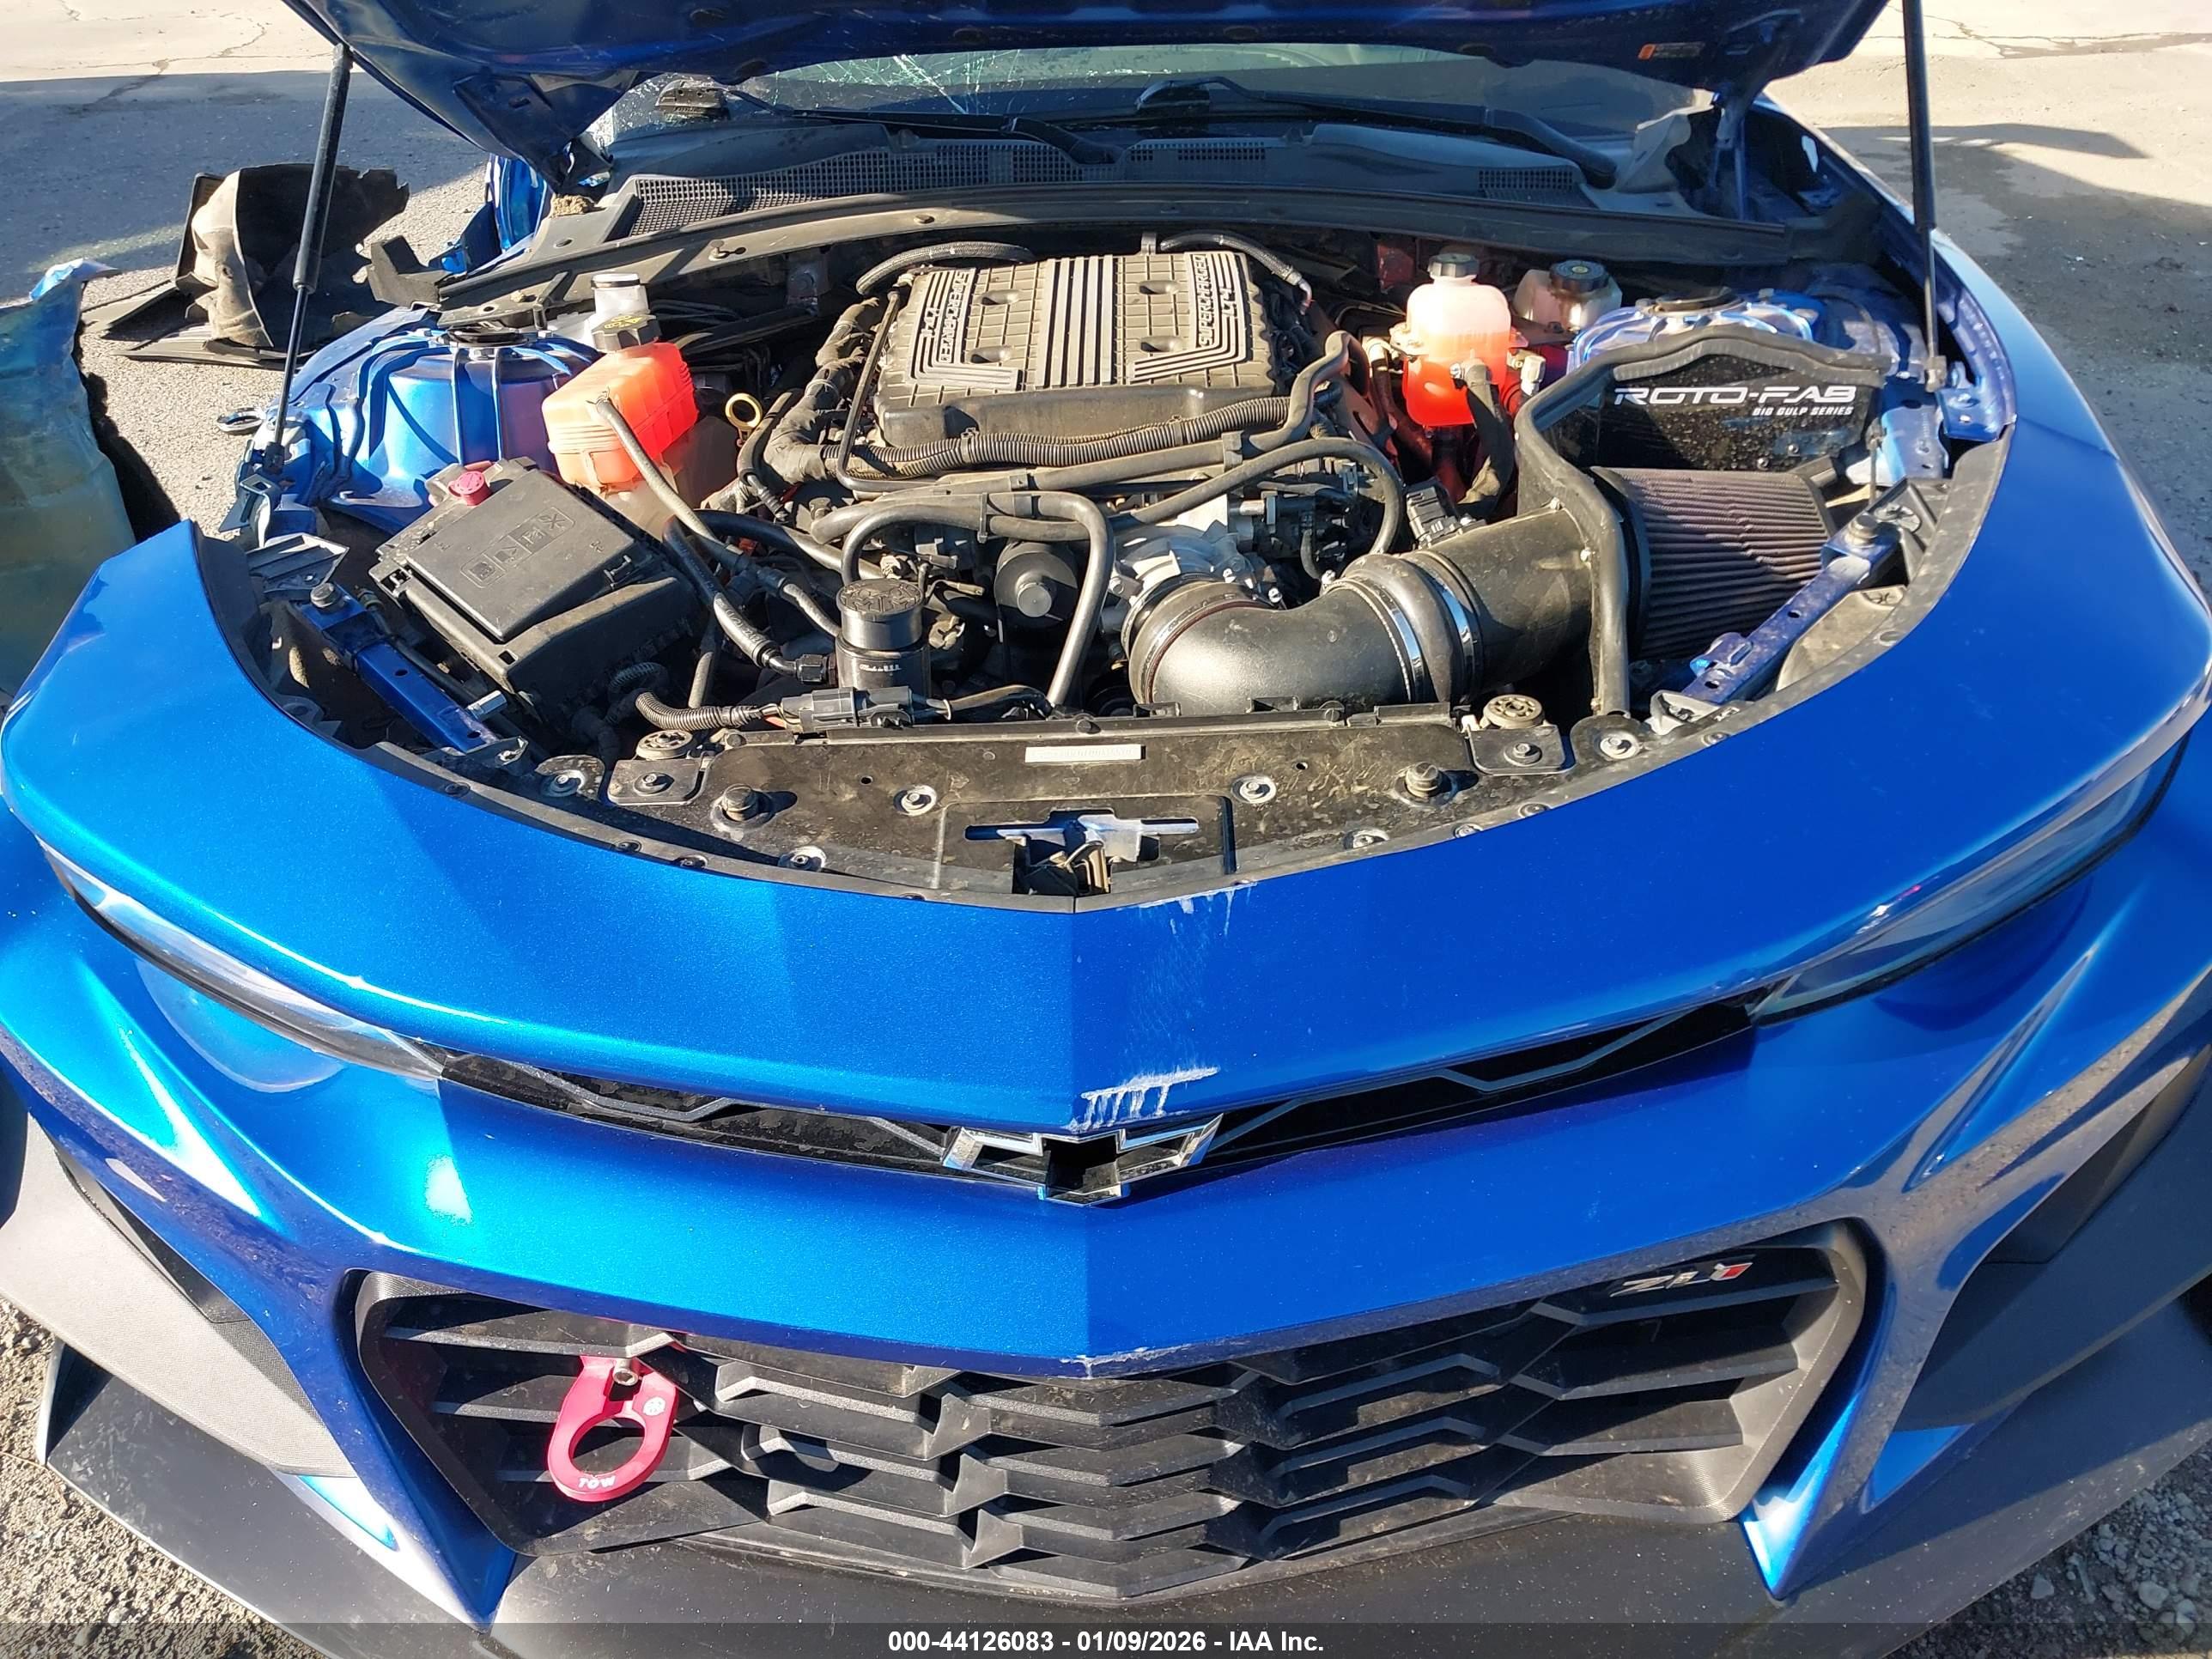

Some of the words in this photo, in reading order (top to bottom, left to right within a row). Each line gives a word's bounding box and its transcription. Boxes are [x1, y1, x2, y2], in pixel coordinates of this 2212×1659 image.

[1193, 254, 1214, 347] SUPERCHARGED
[1218, 288, 1238, 319] LT4
[939, 270, 969, 363] SUPERCHARGED
[1613, 386, 1856, 405] ROTO-FAB
[1752, 406, 1774, 416] BIG
[1776, 406, 1808, 416] GULP
[1809, 406, 1854, 416] SERIES
[1609, 1261, 1753, 1298] ZL1
[578, 1475, 616, 1489] TOW
